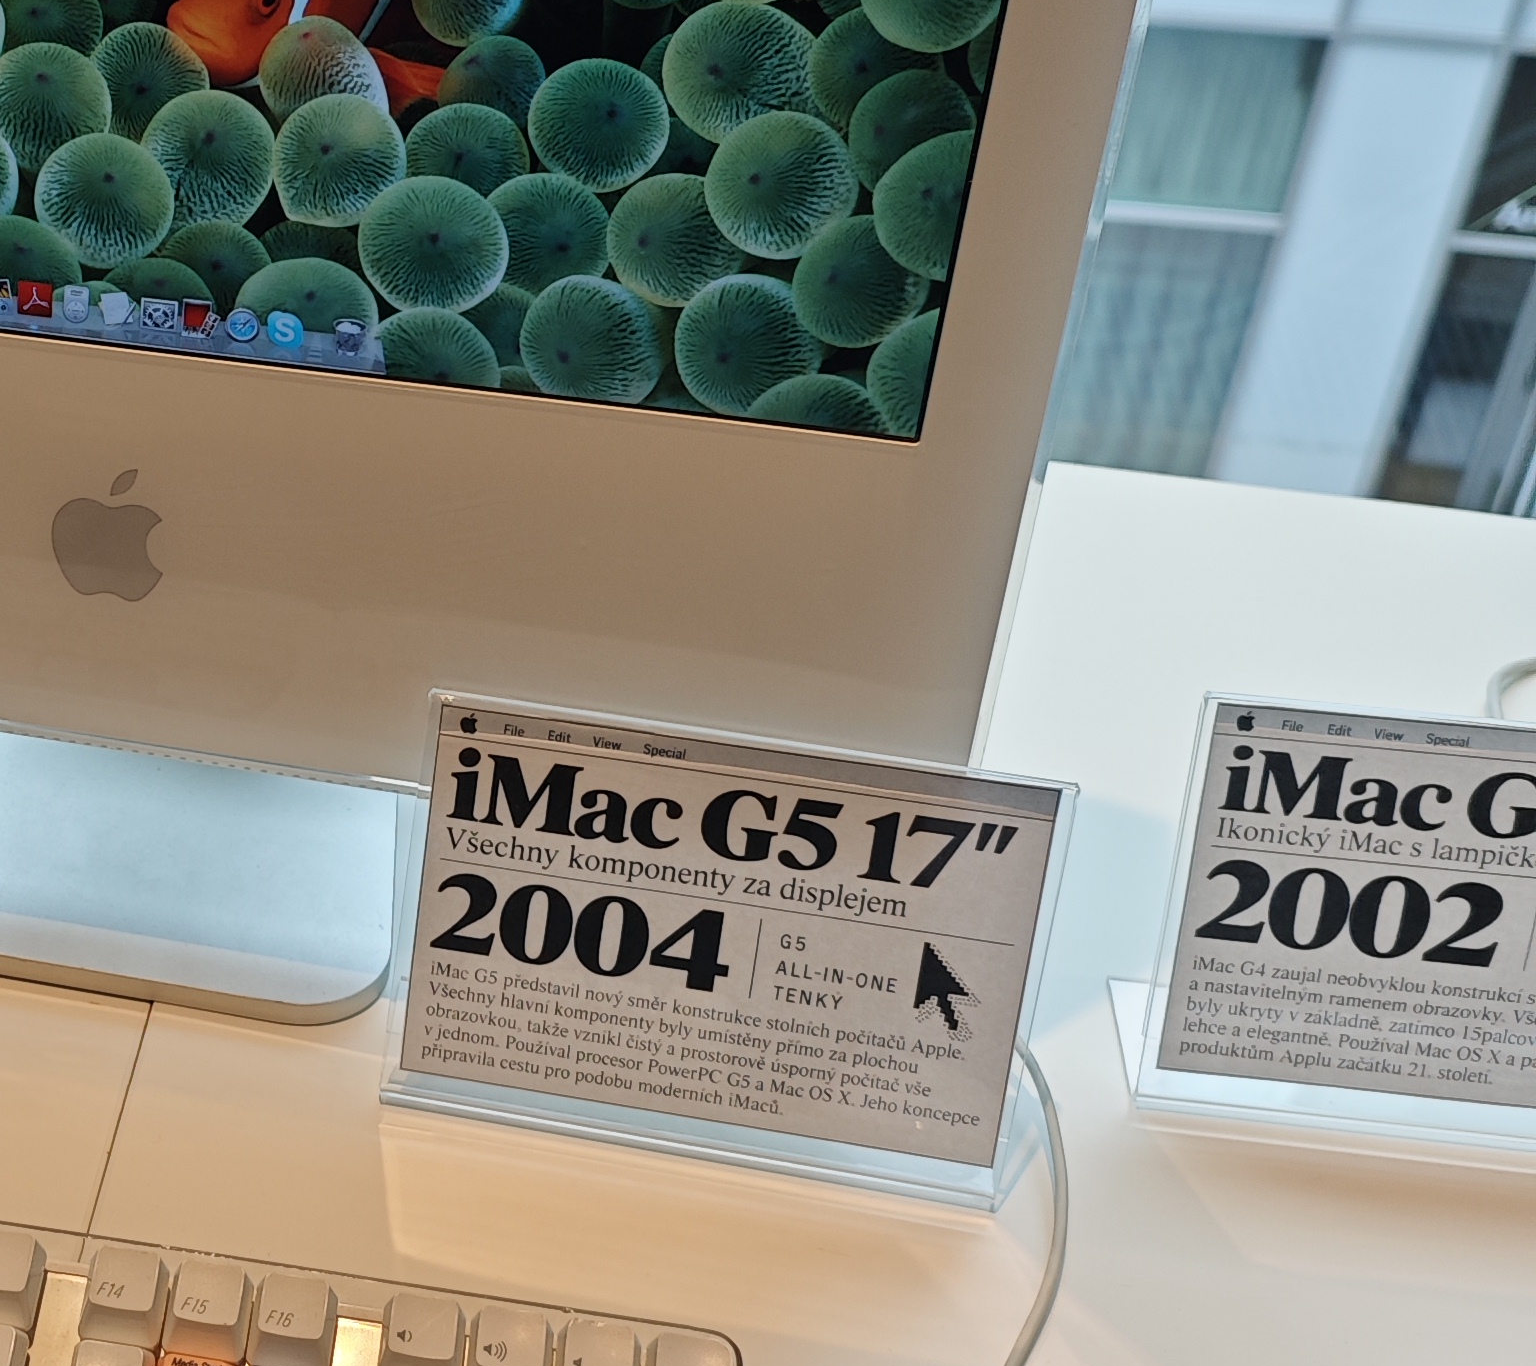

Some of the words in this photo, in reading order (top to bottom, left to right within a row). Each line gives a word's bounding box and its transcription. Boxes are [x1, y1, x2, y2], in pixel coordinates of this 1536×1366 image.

[503, 723, 525, 738] File
[547, 729, 572, 744] Edit
[592, 735, 622, 751] View
[642, 743, 687, 760] Special
[1281, 719, 1304, 733] File
[1327, 723, 1353, 737] Edit
[1374, 727, 1405, 742] View
[1425, 732, 1471, 748] Special
[446, 746, 684, 850] iMac
[700, 789, 845, 871] G5
[856, 811, 1019, 889] 17"
[1217, 744, 1453, 832] iMac
[1466, 771, 1536, 845] G
[1216, 816, 1331, 854] Ikonický
[1339, 828, 1403, 856] iMac
[1409, 842, 1423, 858] s
[1430, 837, 1536, 876] lampičk
[446, 826, 560, 871] Všechny
[568, 844, 736, 896] komponenty
[742, 877, 771, 897] za
[779, 877, 907, 918] displejem
[429, 873, 730, 993] 2004
[1193, 859, 1504, 968] 2002
[780, 933, 806, 952] G5
[430, 960, 469, 981] iMac
[474, 968, 498, 985] G5
[672, 998, 762, 1028] konstrukce
[775, 960, 898, 994] ALL-IN-ONE
[554, 1000, 655, 1034] komponenty
[658, 1017, 693, 1041] byly
[828, 1049, 847, 1063] za
[851, 1050, 919, 1074] plochou
[573, 1028, 622, 1047] vznikl
[666, 1044, 675, 1056] a
[424, 1025, 433, 1036] v
[575, 1050, 644, 1071] procesor
[647, 1058, 723, 1084] PowerPC
[726, 1071, 751, 1089] G5
[754, 1080, 764, 1092] a
[769, 1078, 805, 1098] Mac
[808, 1085, 834, 1103] OS
[859, 1093, 898, 1113] Jeho
[902, 1099, 981, 1127] koncepce
[499, 1058, 540, 1075] cestu
[544, 1065, 571, 1080] pro
[574, 1070, 633, 1090] podobu
[96, 1282, 125, 1300] F14
[181, 1296, 210, 1315] F15
[266, 1310, 294, 1329] F16
